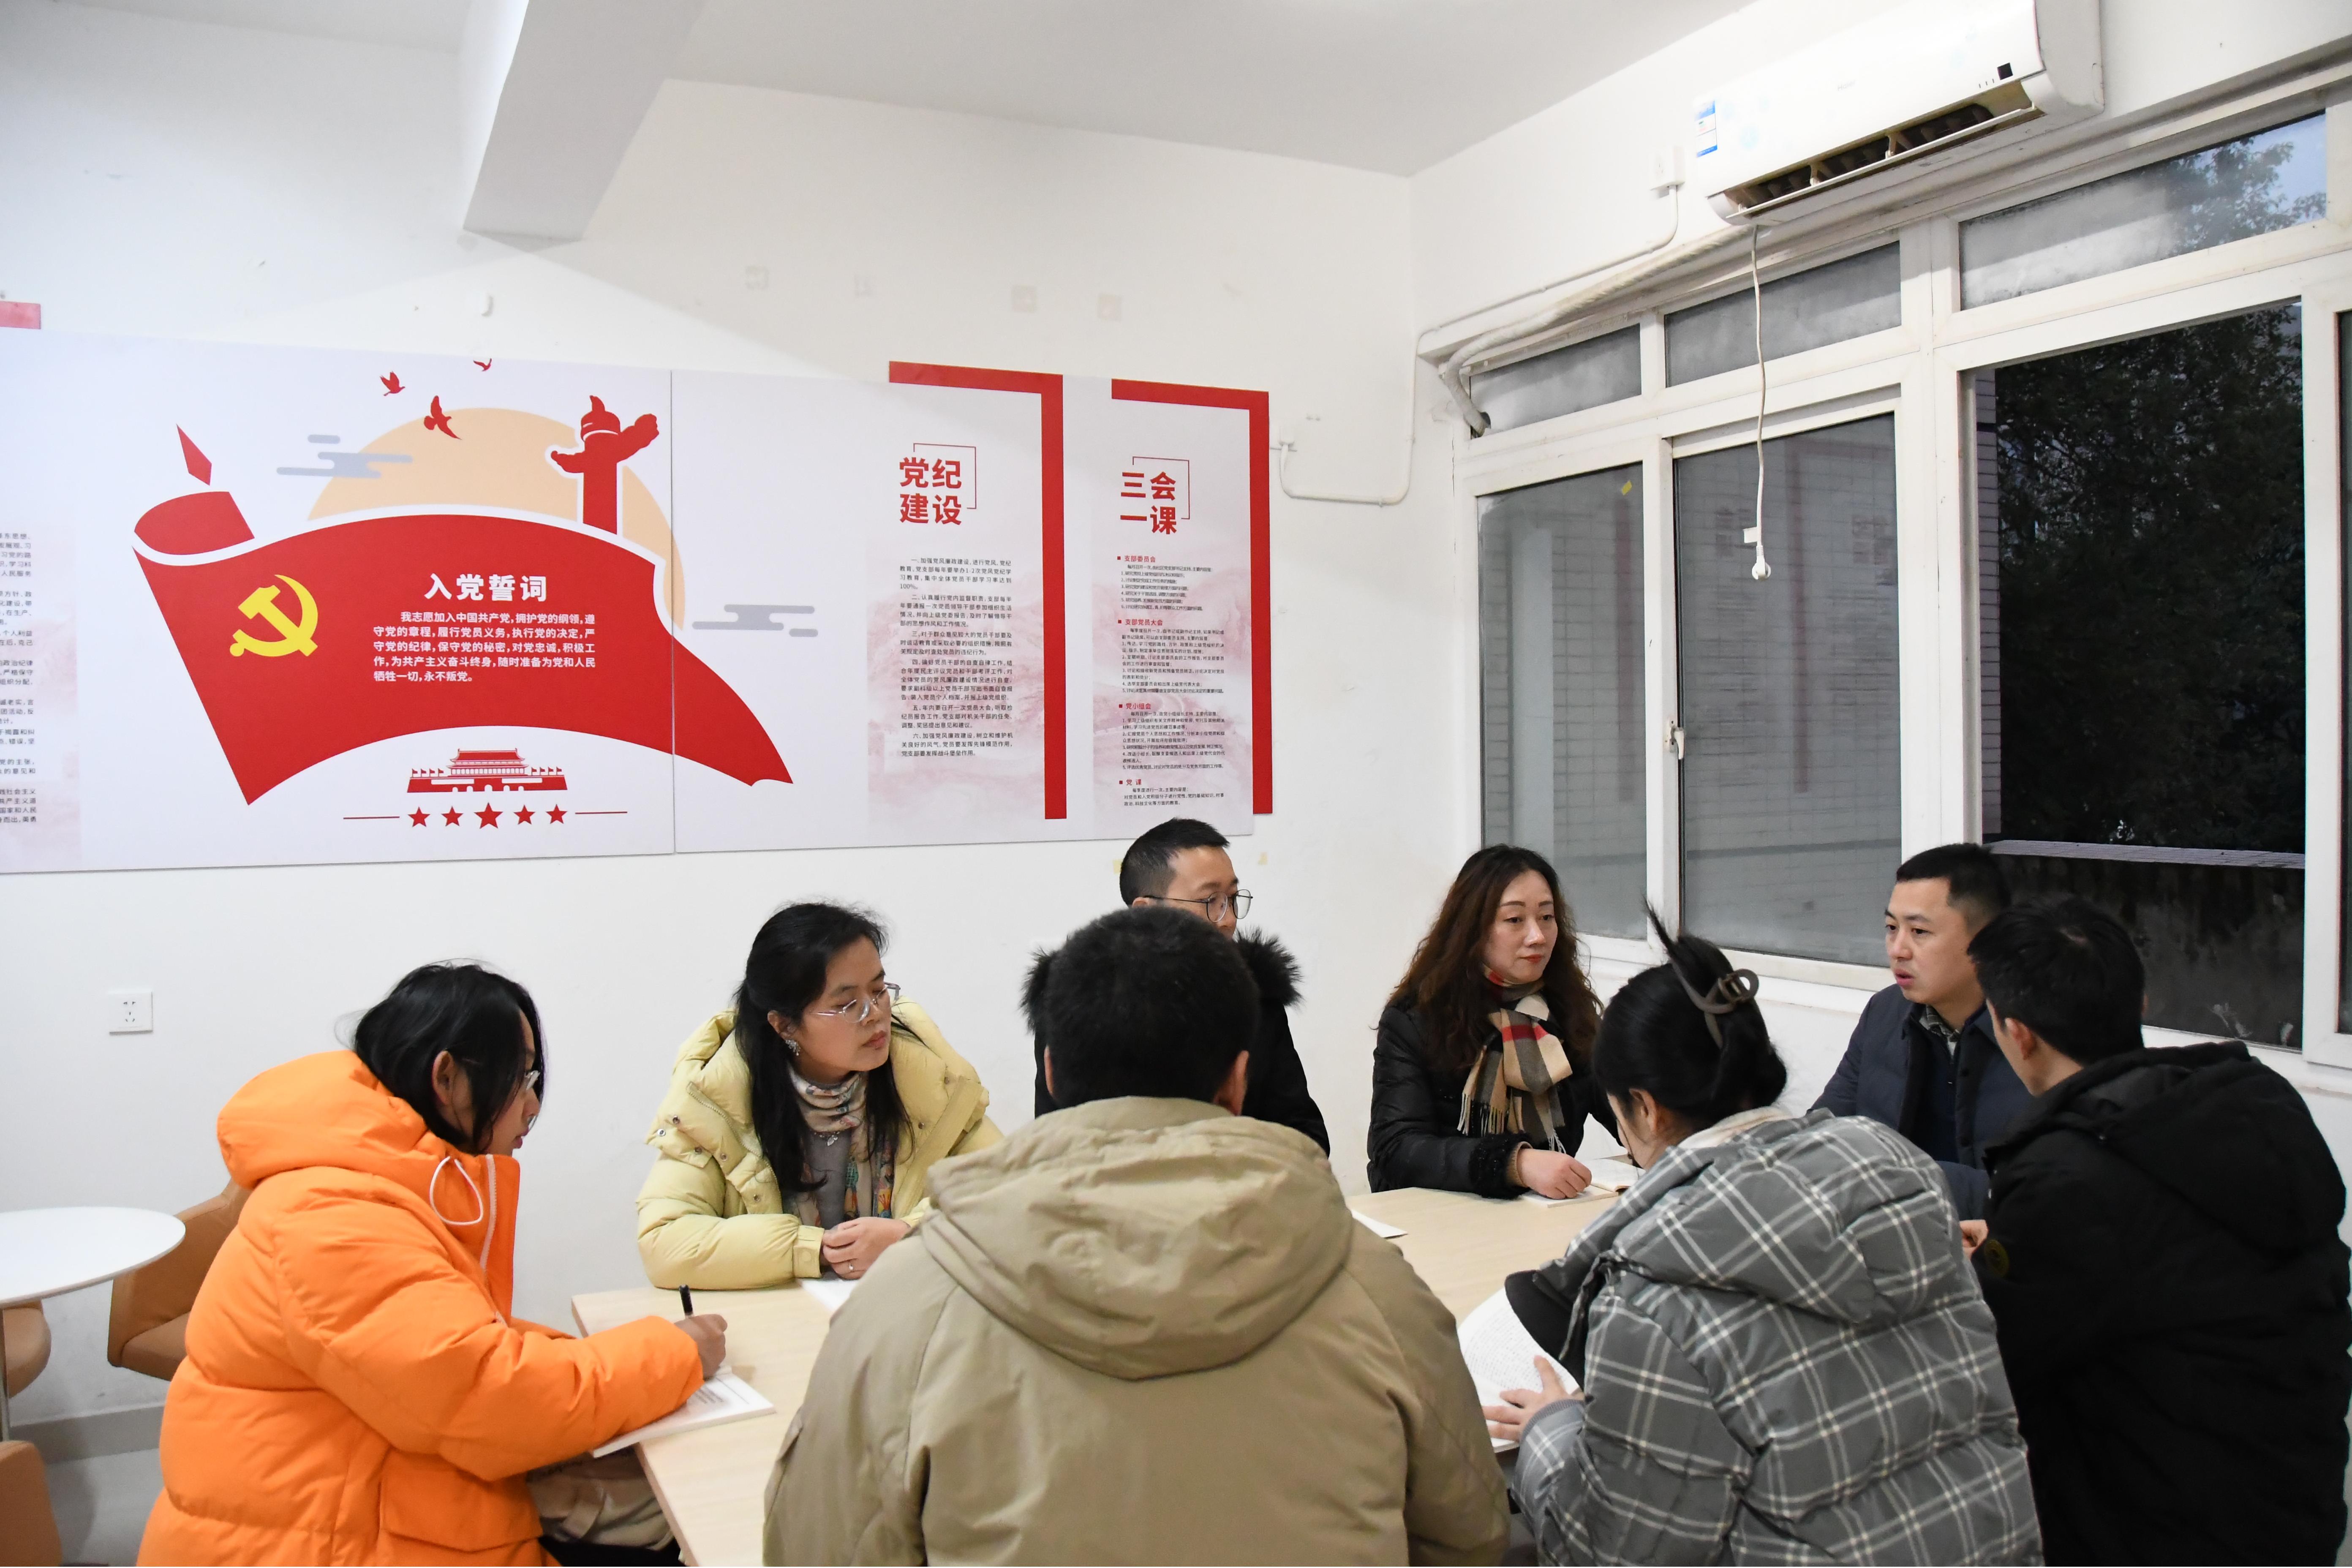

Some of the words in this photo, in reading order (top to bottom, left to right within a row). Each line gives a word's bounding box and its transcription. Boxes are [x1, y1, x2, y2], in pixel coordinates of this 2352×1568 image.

[899, 457, 961, 489] 党纪
[1121, 471, 1176, 501] 三会
[900, 493, 961, 525] 建设
[1120, 505, 1176, 534] 一课
[424, 573, 547, 602] 入党誓词
[400, 611, 595, 625] 我志愿加入中国共产党，拥护党的纲领，遵
[373, 626, 595, 639] 守党的章程，履行党员义务，执行党的决定，严
[373, 641, 595, 653] 守党的纪律，保守党的秘密，对党忠诚，积极工
[373, 656, 596, 668] 作，为共产主义奋斗终身，随时准备为党和人民
[373, 670, 473, 683] 牺牲一切，永不叛党。
